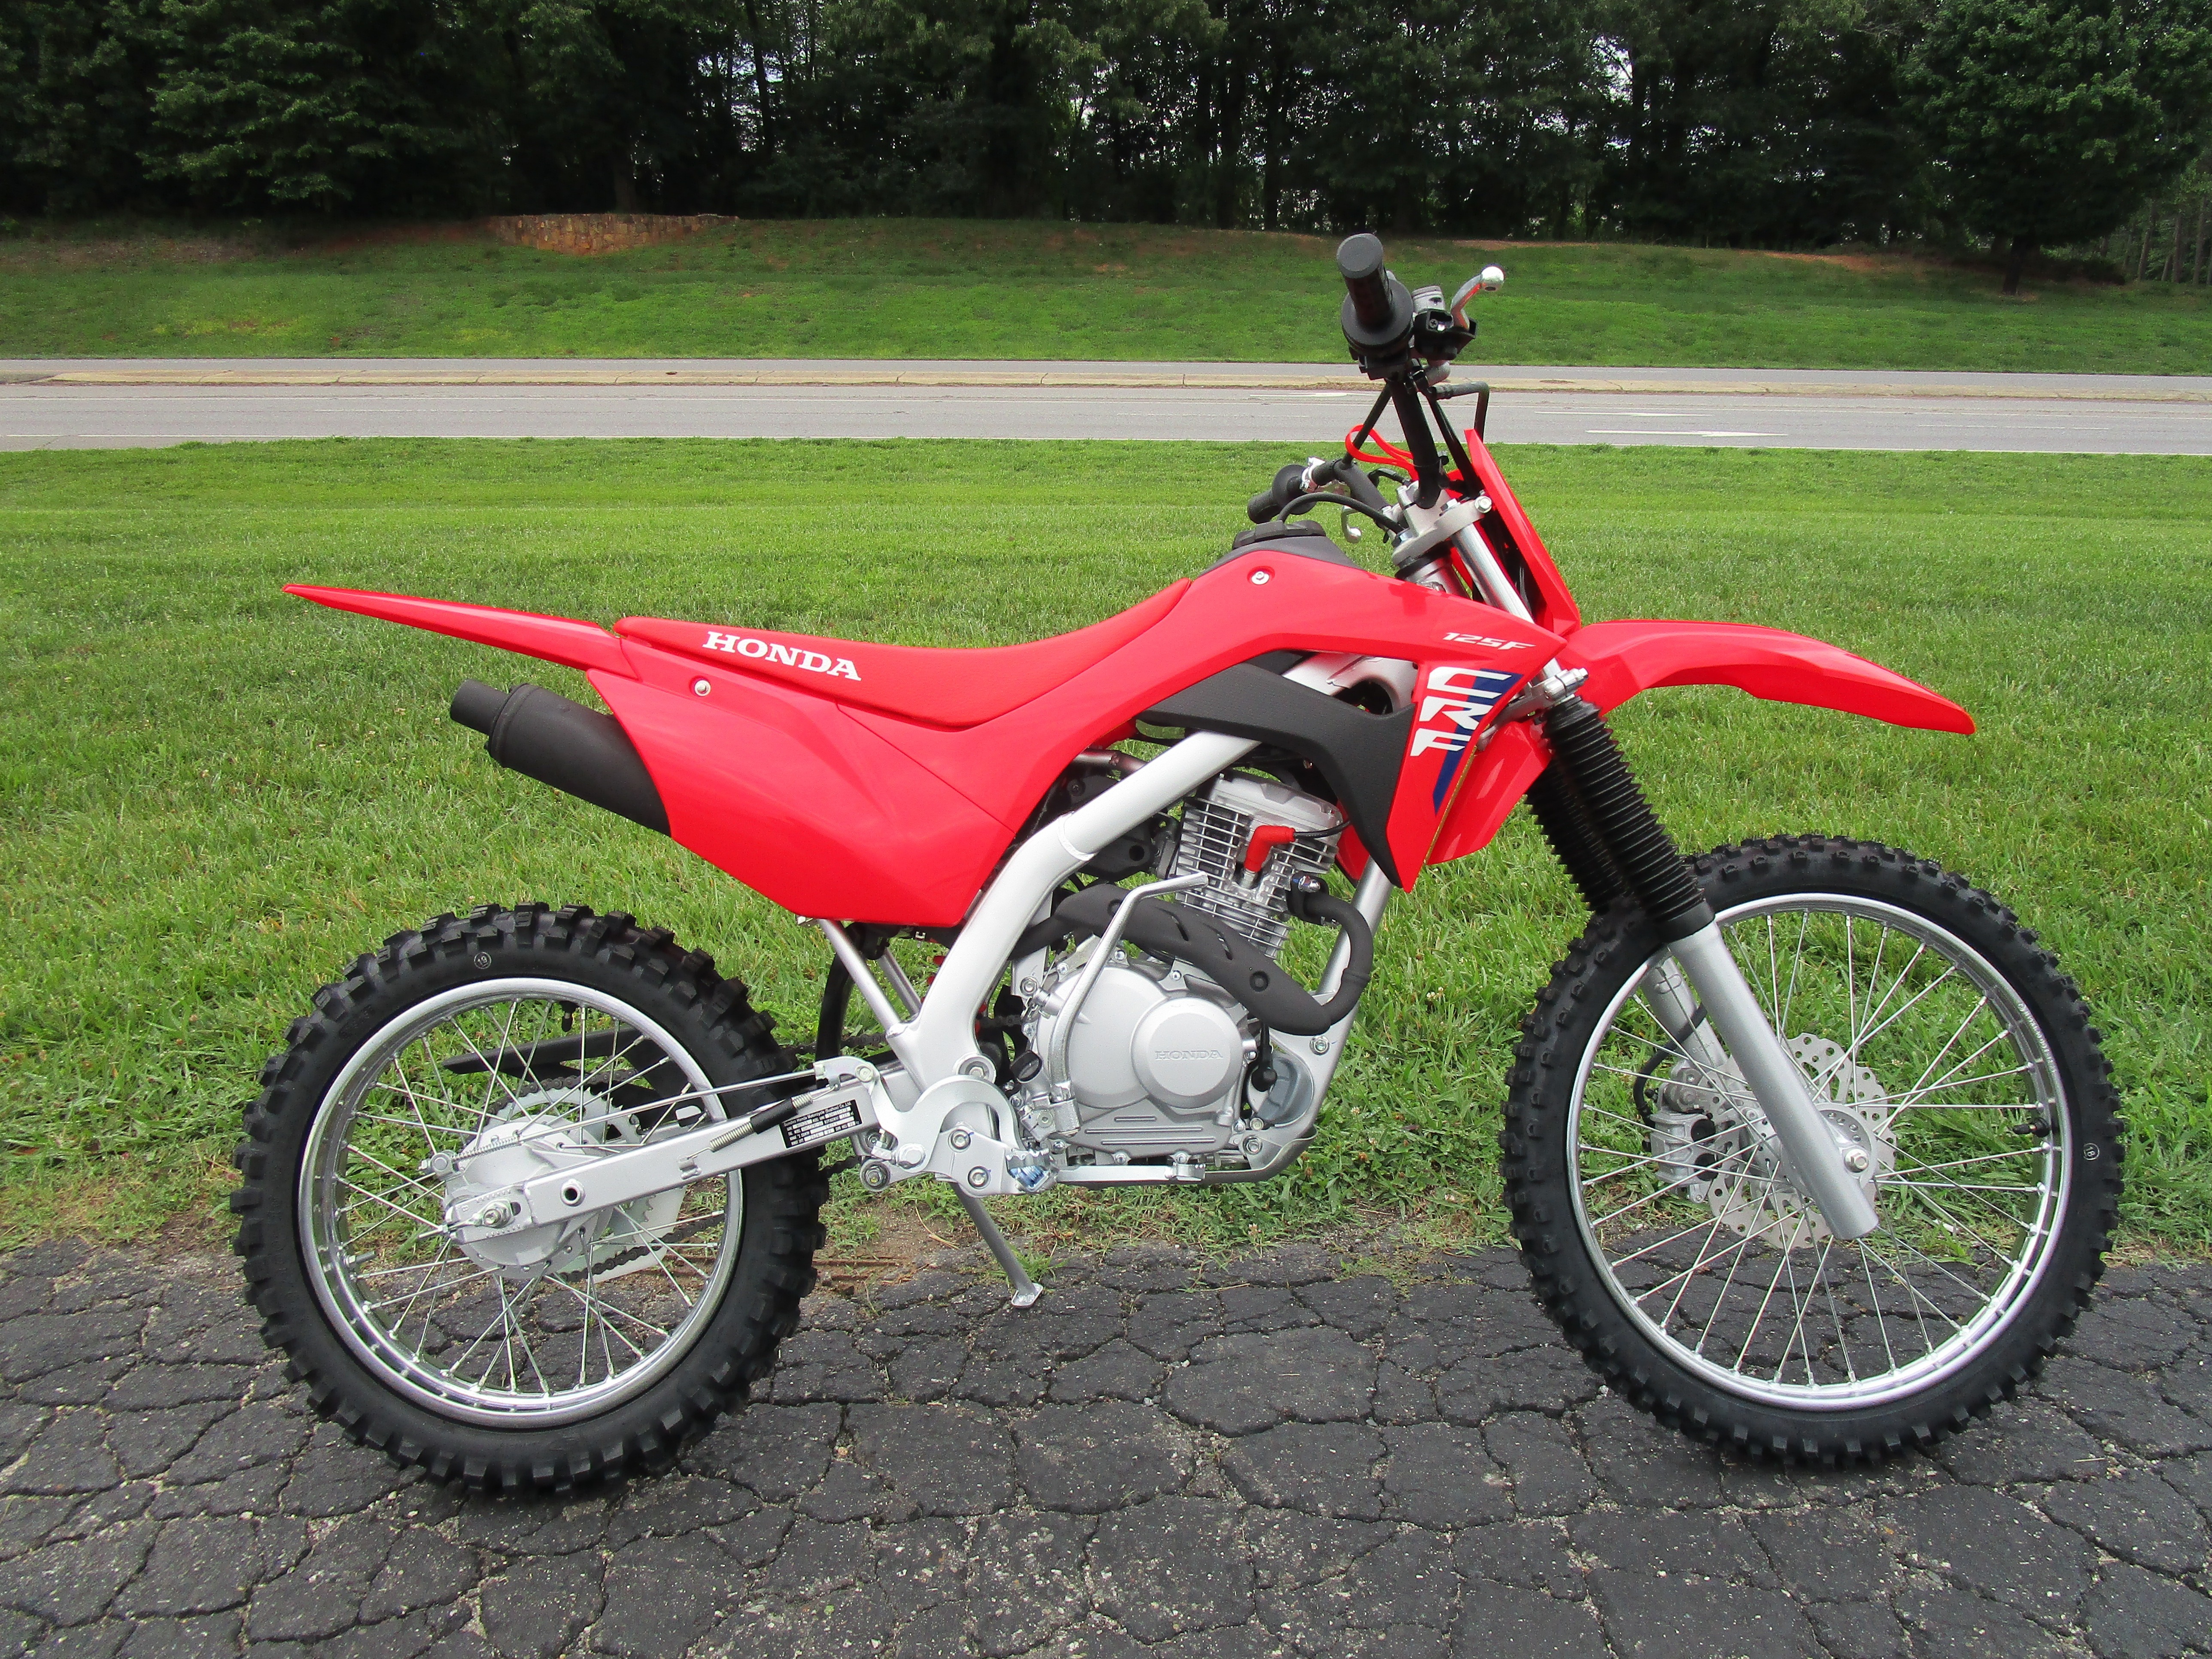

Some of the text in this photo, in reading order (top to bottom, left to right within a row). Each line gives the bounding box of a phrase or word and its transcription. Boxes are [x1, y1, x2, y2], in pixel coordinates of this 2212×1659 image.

[1443, 632, 1536, 650] 125F
[702, 631, 861, 681] HONDA
[1410, 666, 1512, 756] CRF
[476, 954, 489, 967] 19
[1155, 1050, 1223, 1060] HONDA
[2085, 1145, 2097, 1158] 18
